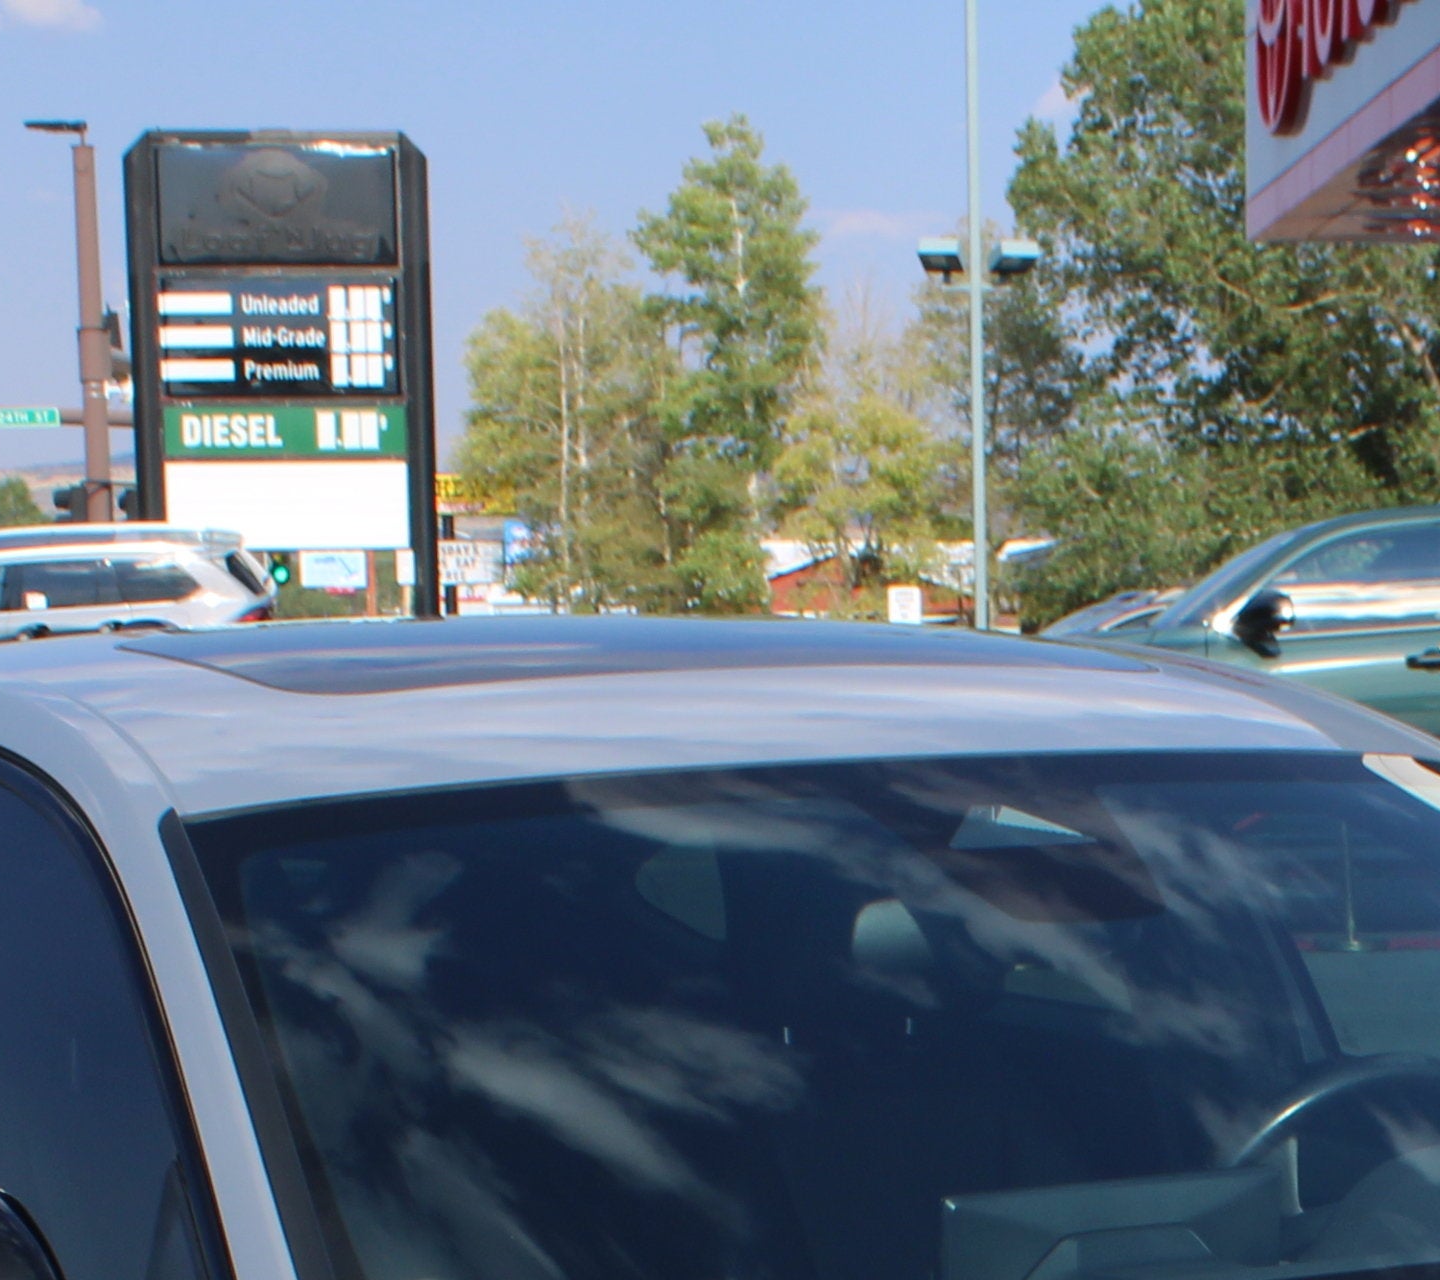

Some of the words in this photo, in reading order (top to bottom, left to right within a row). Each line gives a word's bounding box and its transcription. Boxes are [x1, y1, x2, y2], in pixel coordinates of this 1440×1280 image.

[240, 294, 320, 315] Unleaded
[241, 326, 326, 348] Mid-Grade
[243, 358, 320, 381] Premium
[180, 413, 283, 448] DIESEL
